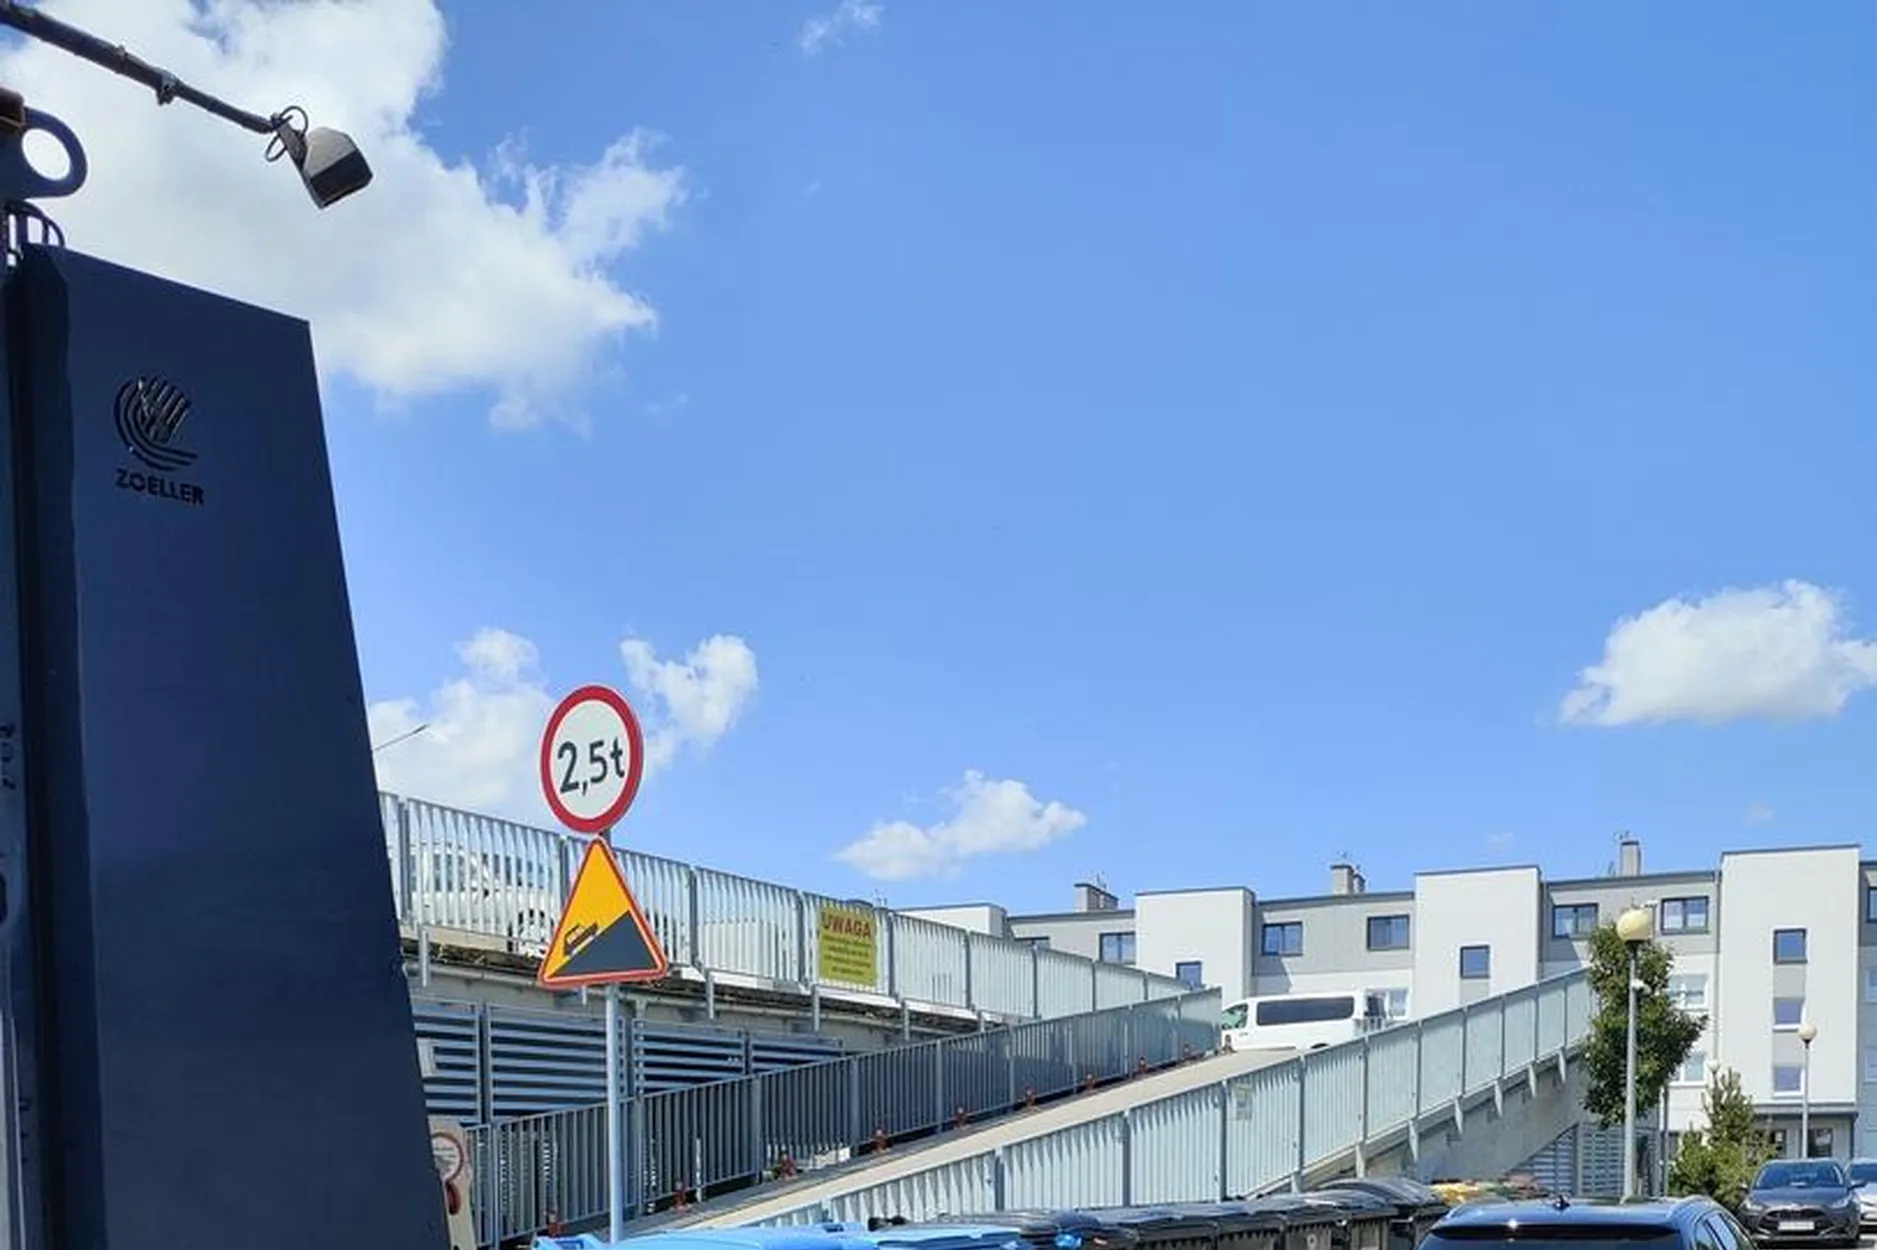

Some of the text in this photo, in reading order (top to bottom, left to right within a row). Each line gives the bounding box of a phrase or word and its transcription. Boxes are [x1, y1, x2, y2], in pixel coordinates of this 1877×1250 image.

[115, 467, 204, 505] ZOELLER
[557, 737, 625, 796] 2,5t
[822, 911, 871, 938] UWAGA
